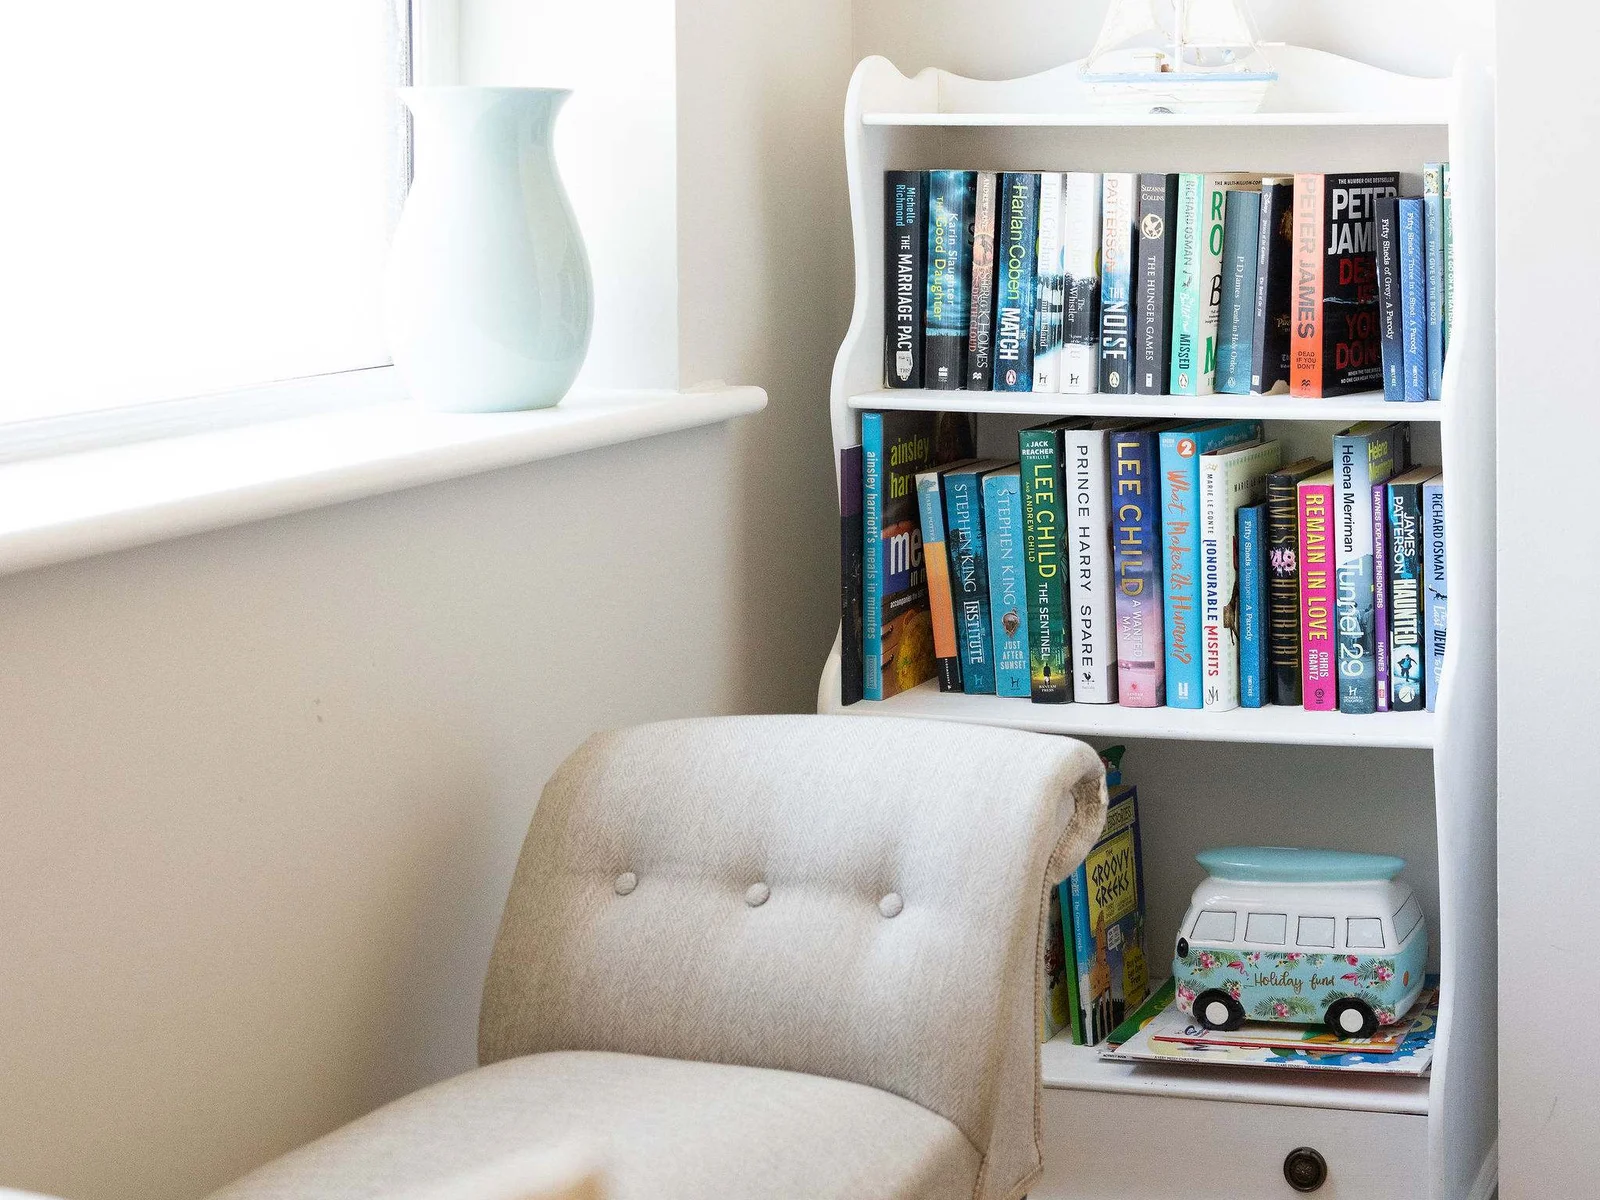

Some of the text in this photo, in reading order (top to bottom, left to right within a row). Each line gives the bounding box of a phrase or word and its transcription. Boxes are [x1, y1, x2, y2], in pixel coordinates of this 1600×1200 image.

[896, 184, 906, 227] Richmond
[906, 187, 916, 224] Michelle
[901, 235, 910, 250] THE
[935, 215, 947, 253] Good
[1008, 184, 1028, 300] Harlan Coben
[1328, 222, 1375, 255] JAM
[1381, 219, 1389, 239] Fifty
[944, 213, 958, 305] Karin Slaughter
[1297, 177, 1316, 339] PETER JAMES
[1382, 240, 1391, 265] Sheds
[1384, 266, 1391, 276] of
[897, 254, 912, 321] MARRIAGE
[931, 260, 946, 321] Daughter
[1109, 287, 1125, 299] THE
[1234, 273, 1243, 299] James
[1384, 277, 1393, 300] Grey:
[1430, 276, 1436, 286] UP
[1068, 287, 1078, 322] Whistler
[1077, 298, 1085, 312] The
[1145, 255, 1156, 361] THE HUNGER GAMES
[1232, 304, 1241, 325] Death
[999, 307, 1021, 360] MATCH
[1102, 300, 1128, 360] NOISE
[1386, 310, 1395, 340] Parody
[1409, 327, 1417, 355] Parody
[976, 321, 990, 368] HOLMES
[1178, 333, 1190, 370] MISSED
[1229, 351, 1238, 374] Orders
[890, 434, 930, 467] ainsley
[1021, 448, 1054, 456] REACHER
[1180, 440, 1193, 456] 2
[1077, 445, 1090, 517] PRINCE
[1167, 470, 1192, 515] What
[1342, 445, 1355, 553] Helena Merriman
[1026, 494, 1034, 532] ANDREW
[1034, 464, 1057, 578] LEE CHILD
[1117, 442, 1144, 597] LEE CHILD
[1207, 500, 1213, 509] LE
[1269, 483, 1297, 544] JAMES
[865, 451, 879, 640] ainsley harriott's meals in minutes
[955, 484, 977, 593] STEPHEN KING
[997, 488, 1016, 605] STEPHEN KING
[1027, 535, 1036, 563] CHILD
[1167, 521, 1192, 572] Makes
[1244, 520, 1252, 540] Fifty
[1393, 496, 1404, 574] PATTERSON
[1404, 512, 1416, 557] JAMES
[1432, 493, 1445, 581] RICHARD OSMAN
[1079, 526, 1092, 592] HARRY
[1245, 541, 1254, 567] Sheds
[1305, 493, 1328, 641] REMAIN IN LOVE
[1340, 558, 1364, 637] Tunnel
[1375, 561, 1384, 609] PENSIONERS
[1038, 582, 1051, 661] THE SENTINEL
[1203, 539, 1219, 677] HONOURABLE MISFITS
[1393, 579, 1418, 645] HAUNTED
[963, 599, 985, 665] INSTITUTE
[1003, 640, 1021, 649] JUST
[1080, 605, 1093, 667] SPARE
[1122, 616, 1132, 640] MAN
[1132, 599, 1144, 658] A WANTED
[1170, 595, 1193, 665] Human?
[1245, 613, 1253, 642] Parody
[1434, 629, 1446, 657] DEVIL
[1000, 661, 1026, 670] SUNSET
[1002, 650, 1023, 660] AFTER
[1309, 649, 1319, 681] FRANTZ
[1319, 651, 1329, 678] CHRIS
[1340, 643, 1364, 677] 29
[1377, 641, 1385, 672] HAYNES
[1092, 847, 1129, 887] GROOVY
[1095, 870, 1129, 908] GREEKS
[1254, 971, 1335, 994] Holiday fund
